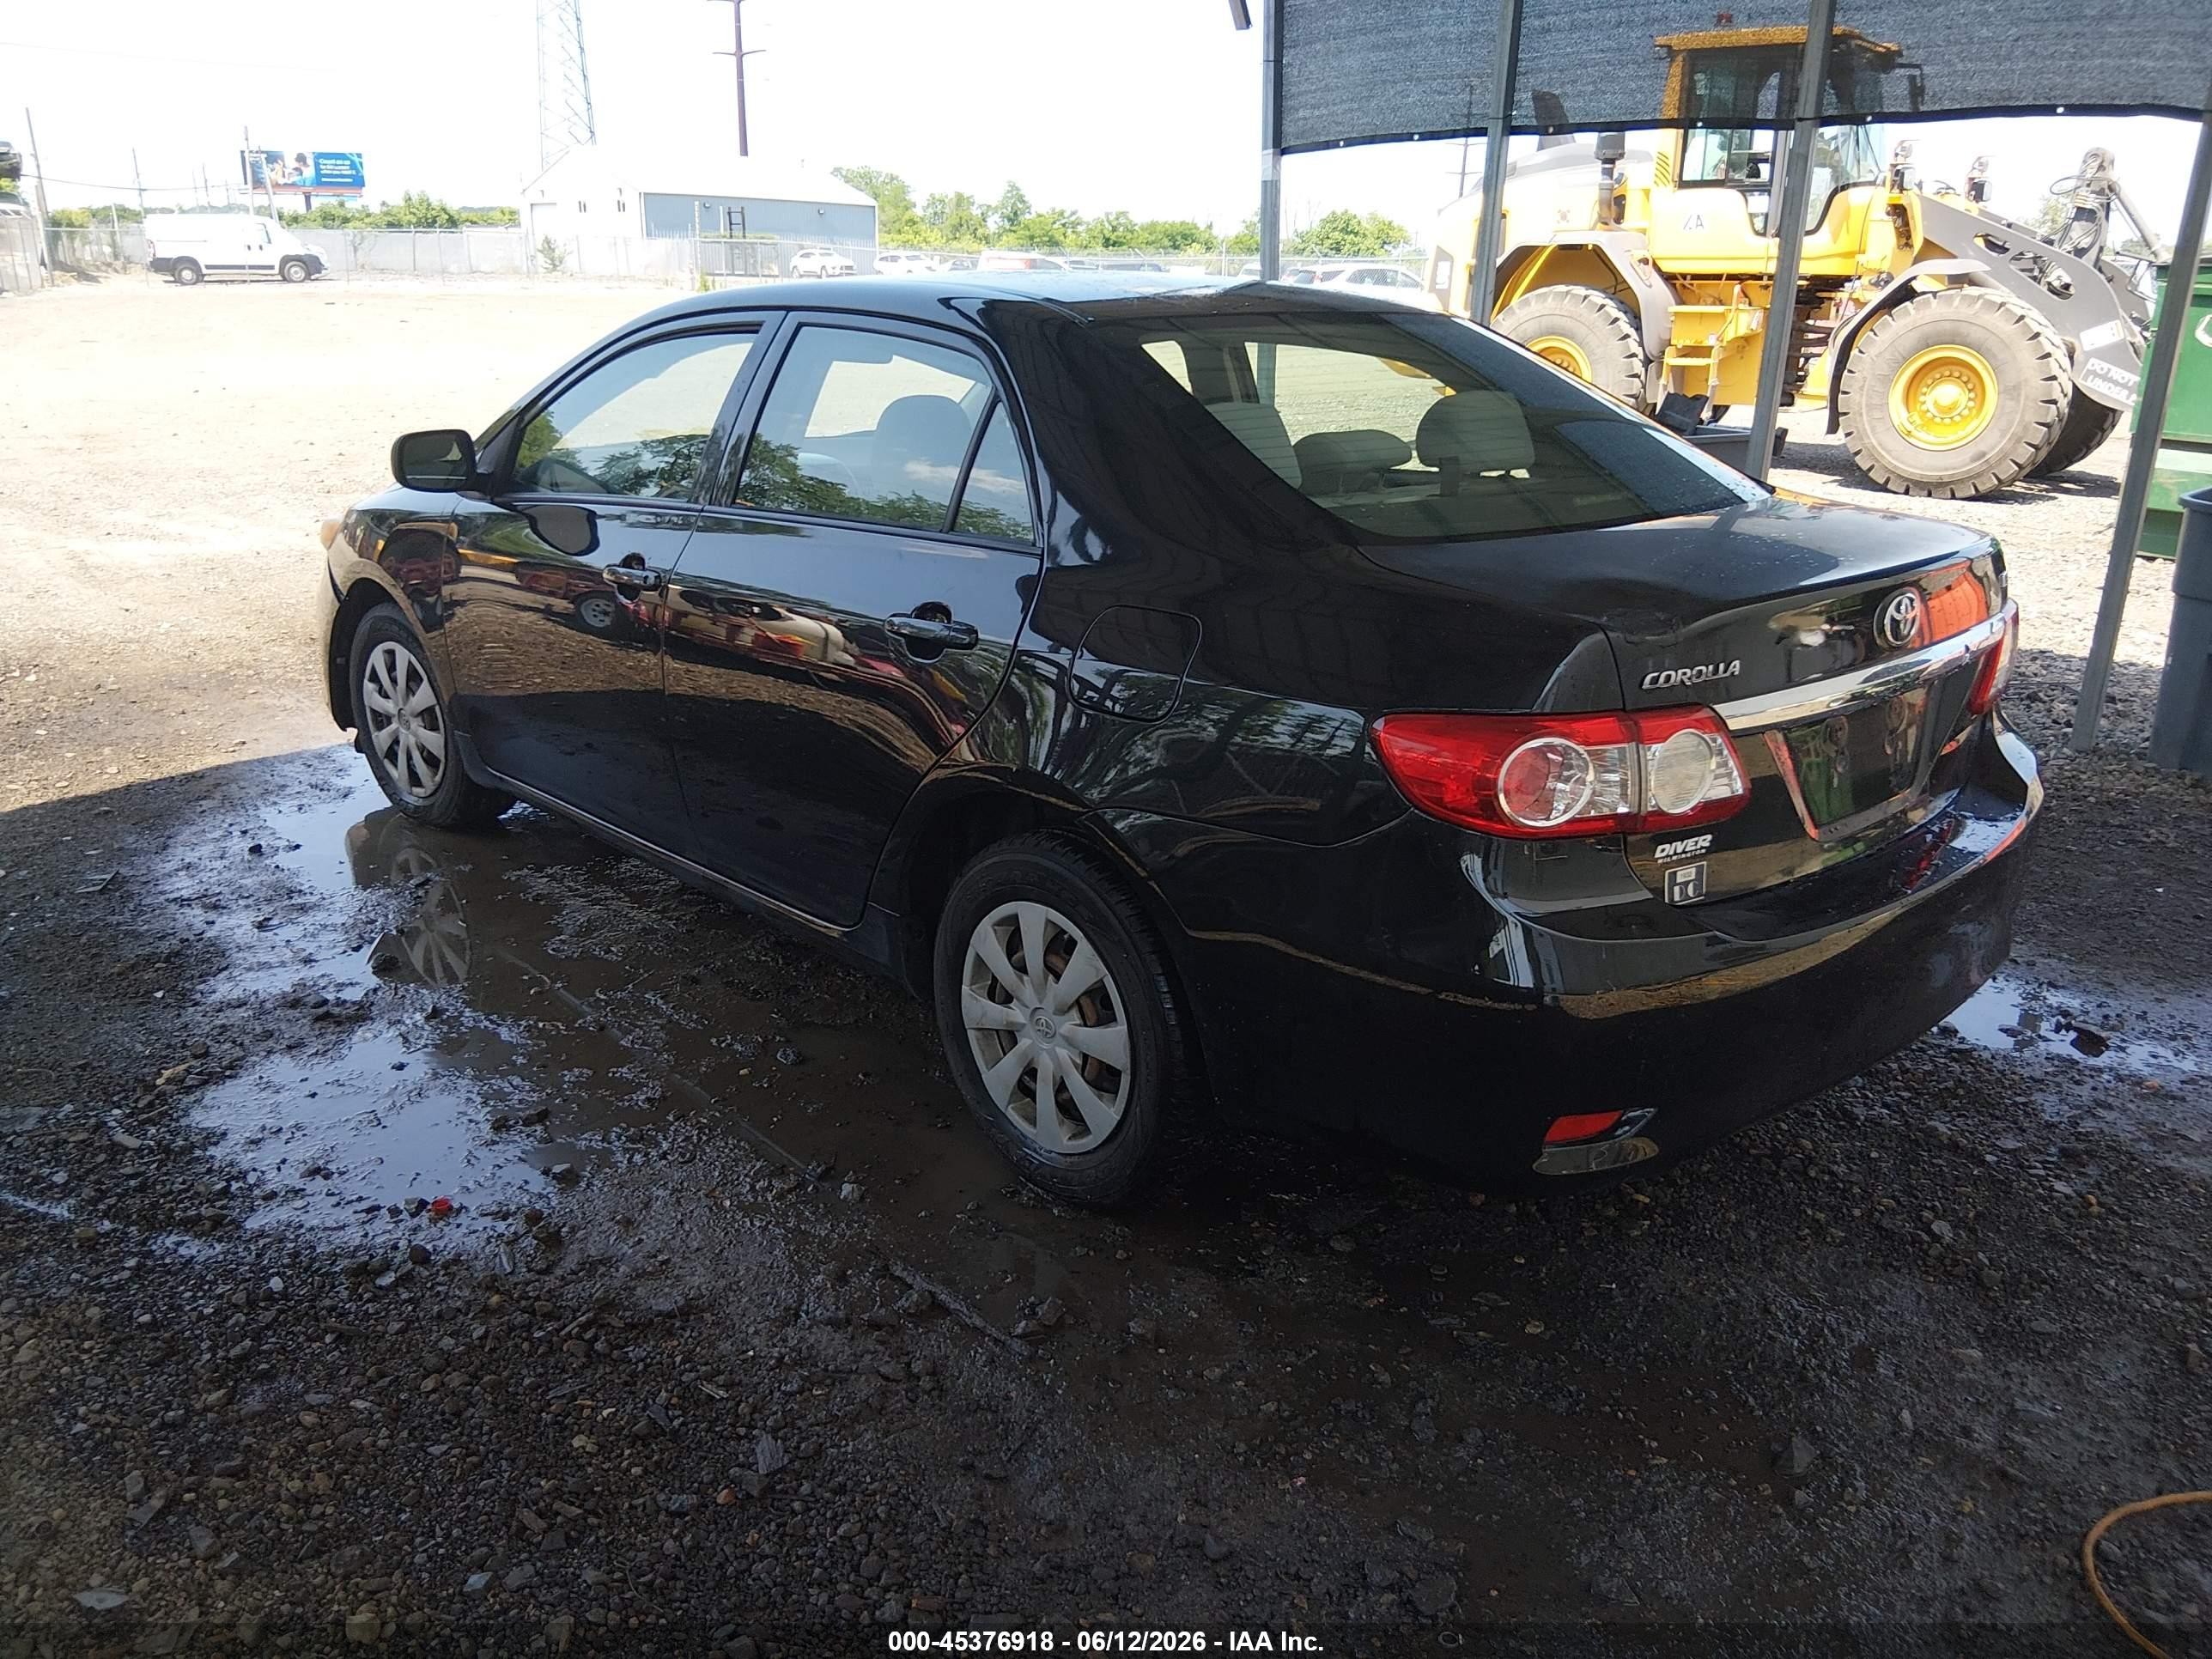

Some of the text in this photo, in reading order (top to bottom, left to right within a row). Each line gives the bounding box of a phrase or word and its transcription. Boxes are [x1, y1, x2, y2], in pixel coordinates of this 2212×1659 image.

[2087, 359, 2137, 386] DO NOT
[1641, 659, 1741, 690] COROLLA
[1654, 834, 1713, 859] DIVER
